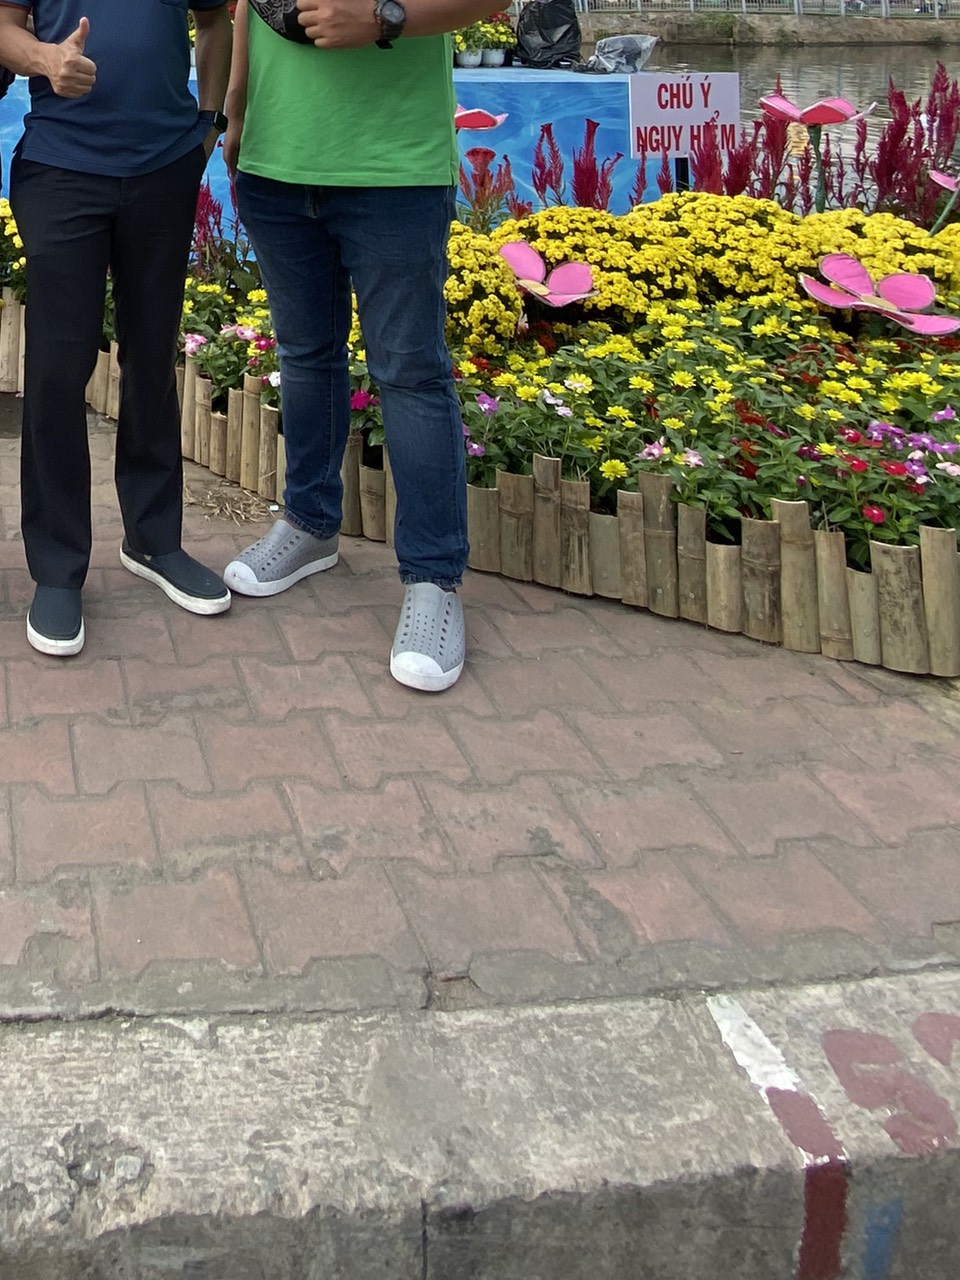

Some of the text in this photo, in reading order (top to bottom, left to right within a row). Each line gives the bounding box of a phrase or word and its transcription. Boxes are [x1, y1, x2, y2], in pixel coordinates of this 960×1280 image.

[657, 75, 711, 109] CHÚ Ý
[636, 125, 683, 153] NGUY
